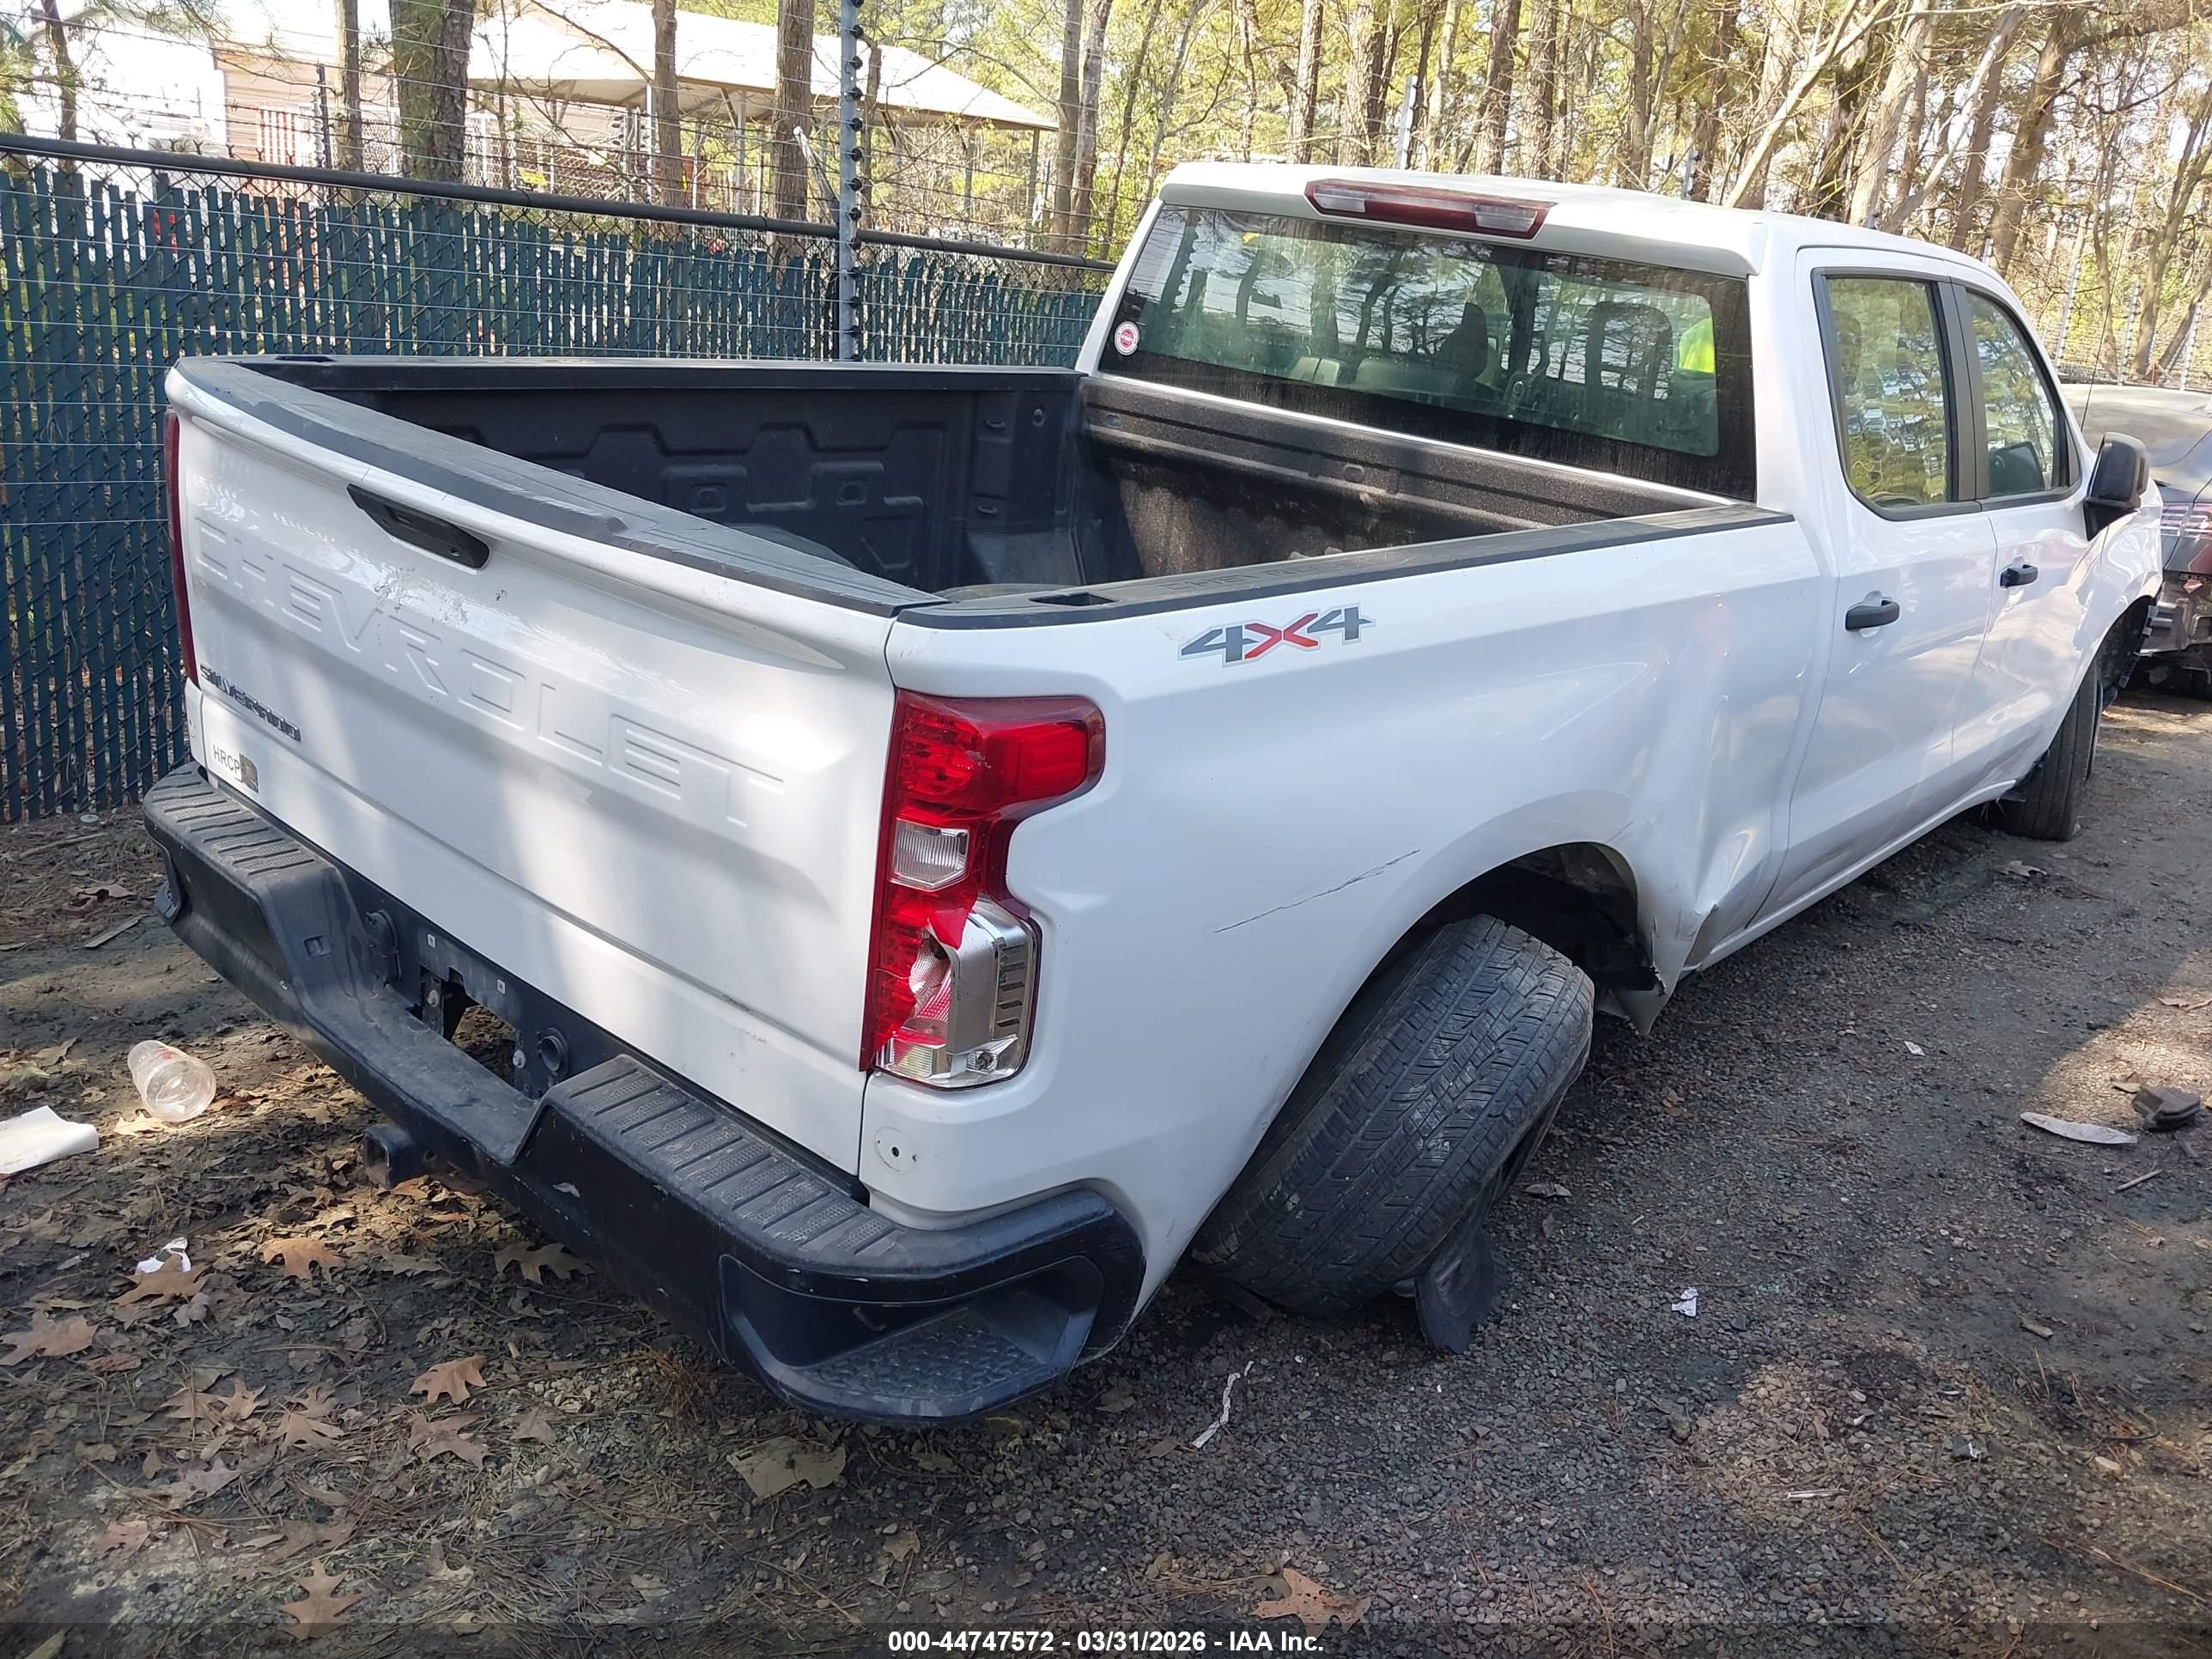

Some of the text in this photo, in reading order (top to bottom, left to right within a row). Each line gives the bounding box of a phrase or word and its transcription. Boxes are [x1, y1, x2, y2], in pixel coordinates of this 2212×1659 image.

[195, 516, 784, 827] CHEVROLET
[200, 664, 301, 742] SILVERADO
[212, 744, 241, 775] HRCP
